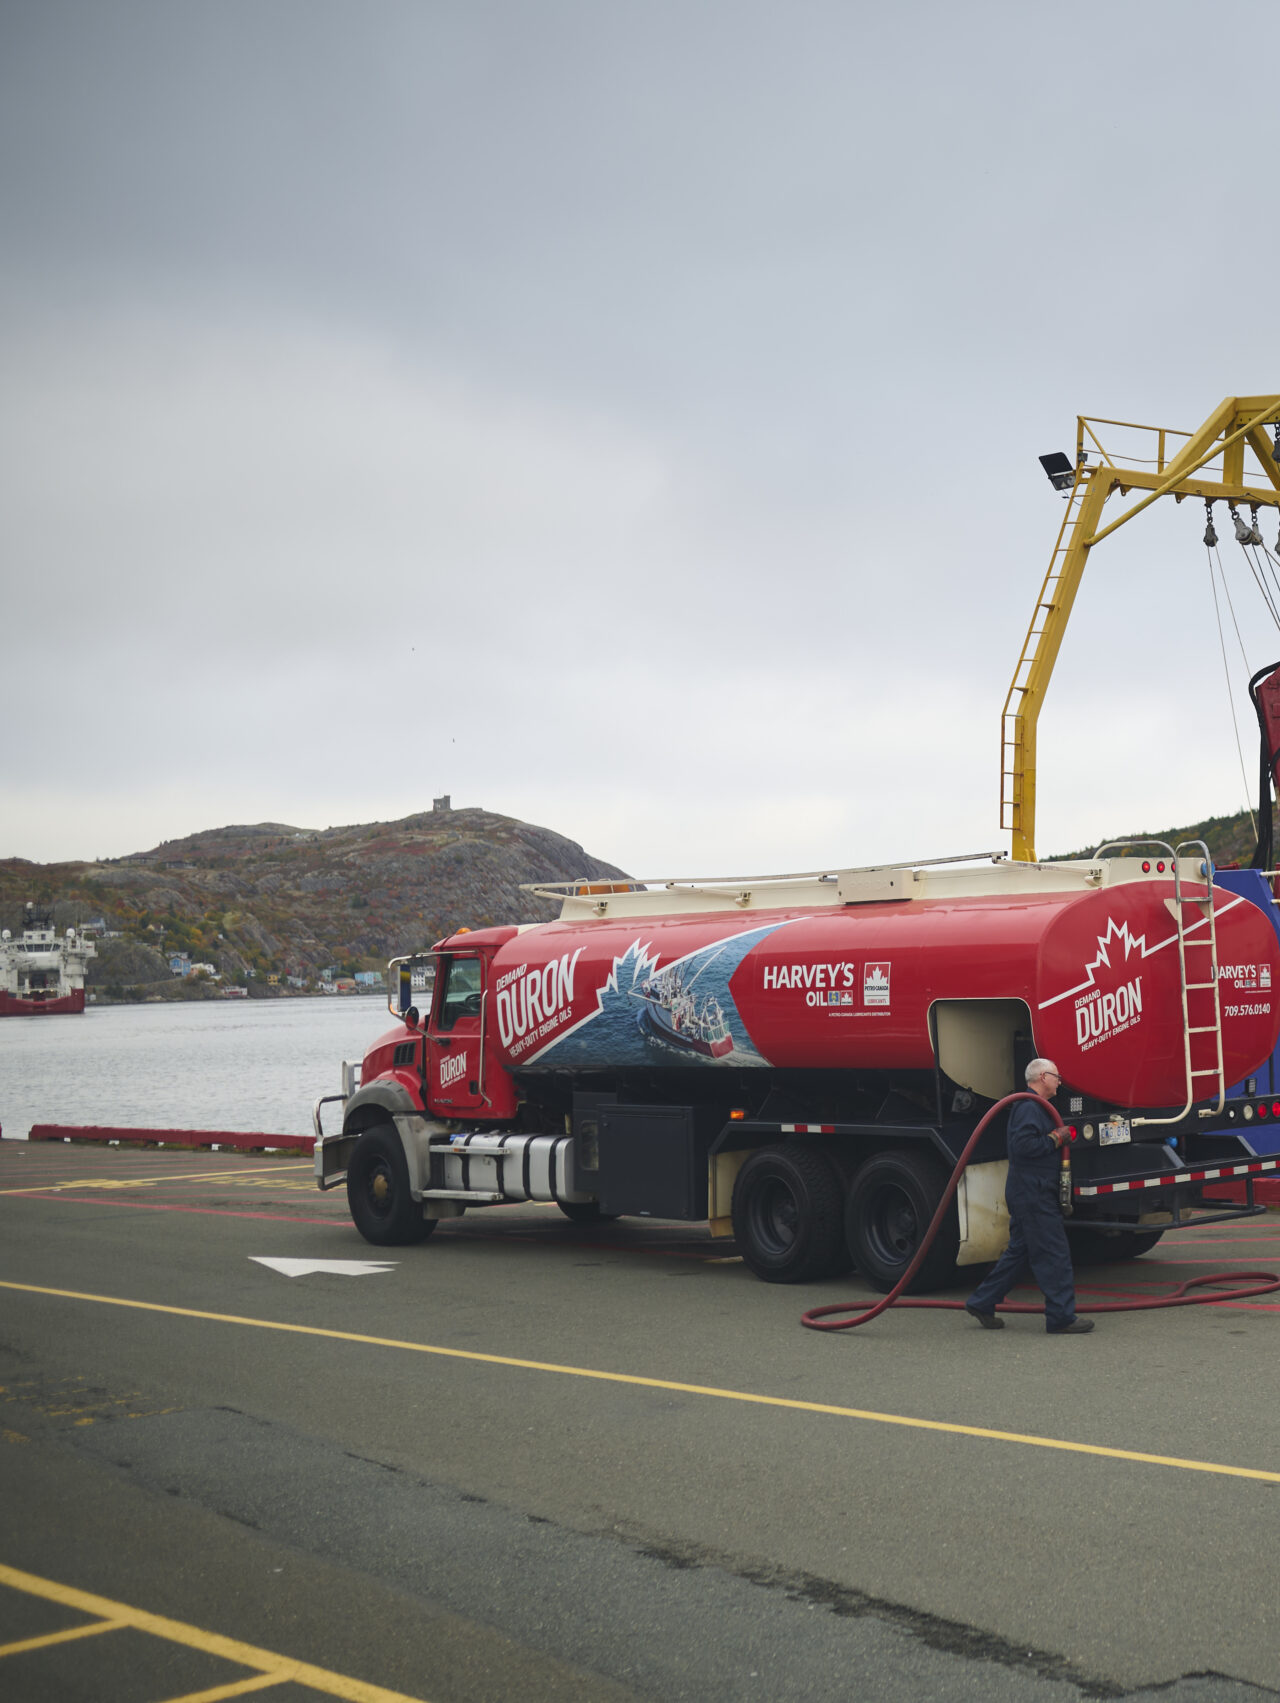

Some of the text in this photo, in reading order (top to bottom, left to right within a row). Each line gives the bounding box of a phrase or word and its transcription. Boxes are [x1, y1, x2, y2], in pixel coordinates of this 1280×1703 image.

[496, 963, 527, 992] DEMAND
[764, 961, 855, 989] HARVEY'S
[1234, 980, 1246, 988] OIL
[496, 947, 582, 1049] DURON
[805, 991, 828, 1007] OIL
[1075, 989, 1101, 1009] DEMAND
[1075, 977, 1142, 1046] DURON
[1224, 1003, 1271, 1017] 709.576.0140
[509, 1006, 572, 1058] HEAVY-DUTY ENGINE OILS
[1081, 1015, 1141, 1052] HEAVY-DUTY ENGINE OILS
[440, 1051, 467, 1085] DURON
